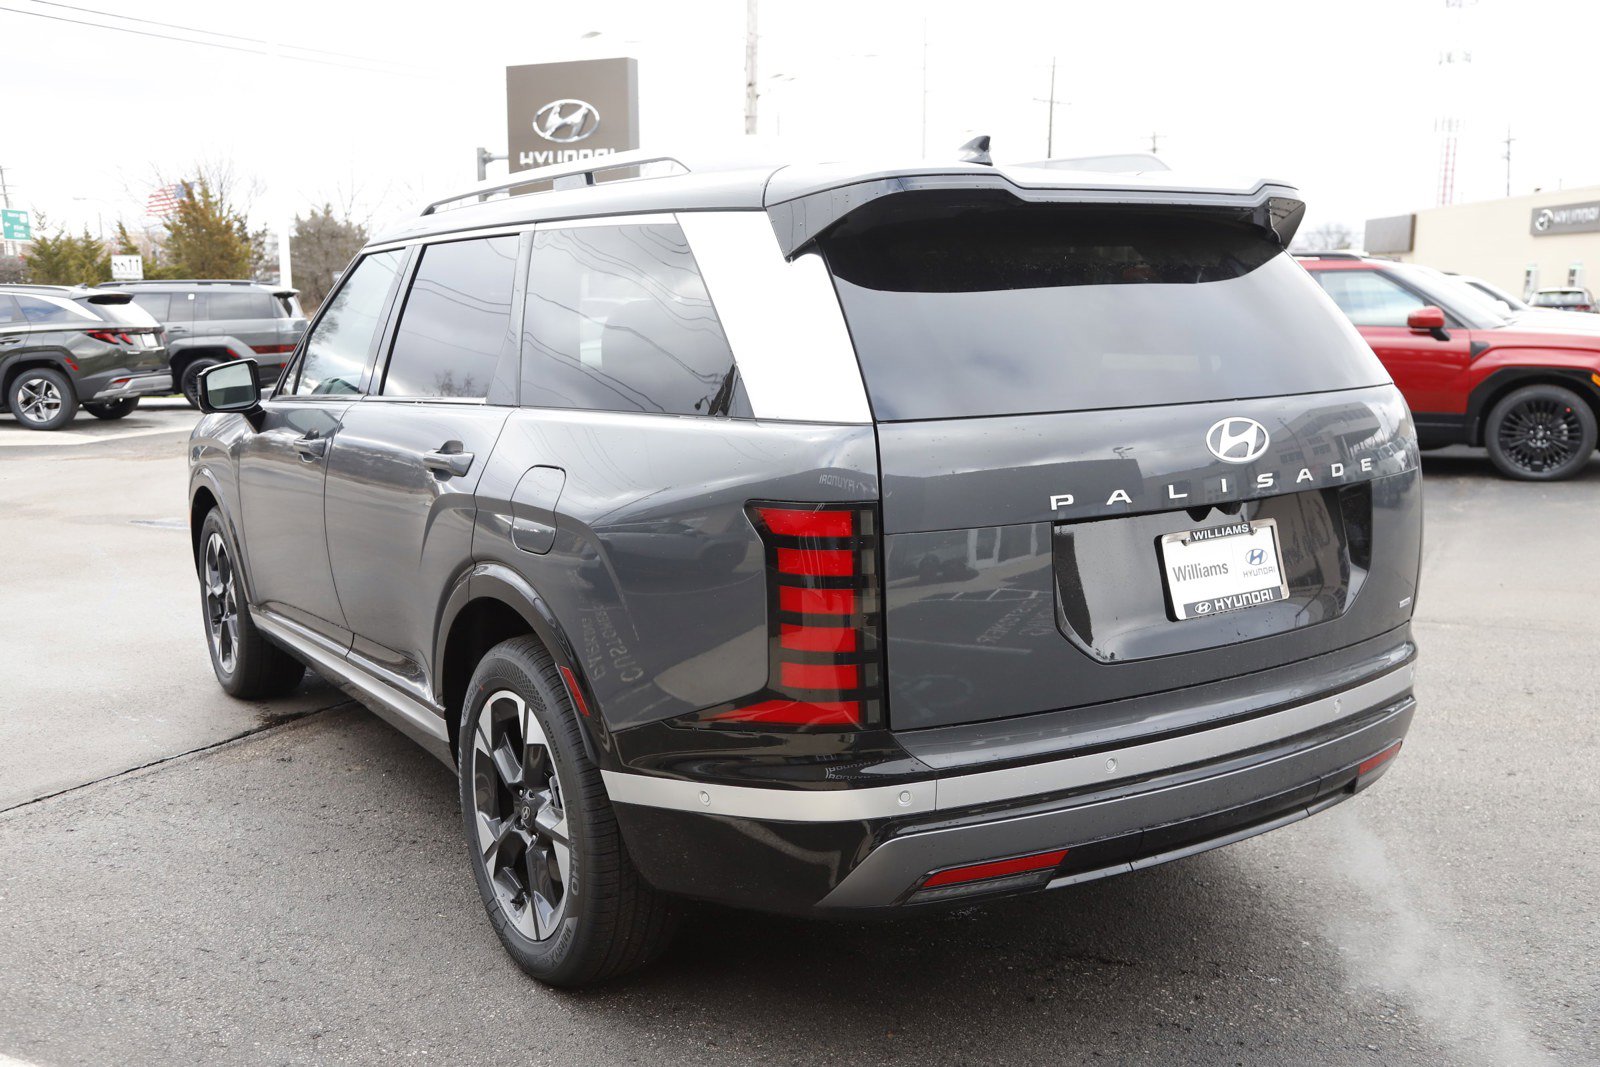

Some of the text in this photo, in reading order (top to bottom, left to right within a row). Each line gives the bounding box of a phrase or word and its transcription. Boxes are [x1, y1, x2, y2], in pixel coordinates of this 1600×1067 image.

[1049, 457, 1373, 511] PALISADE
[1192, 523, 1249, 540] WILLIAMS
[1171, 561, 1229, 584] Williams
[1242, 565, 1276, 579] HYUNDAI
[1213, 588, 1274, 612] HYUNDAI
